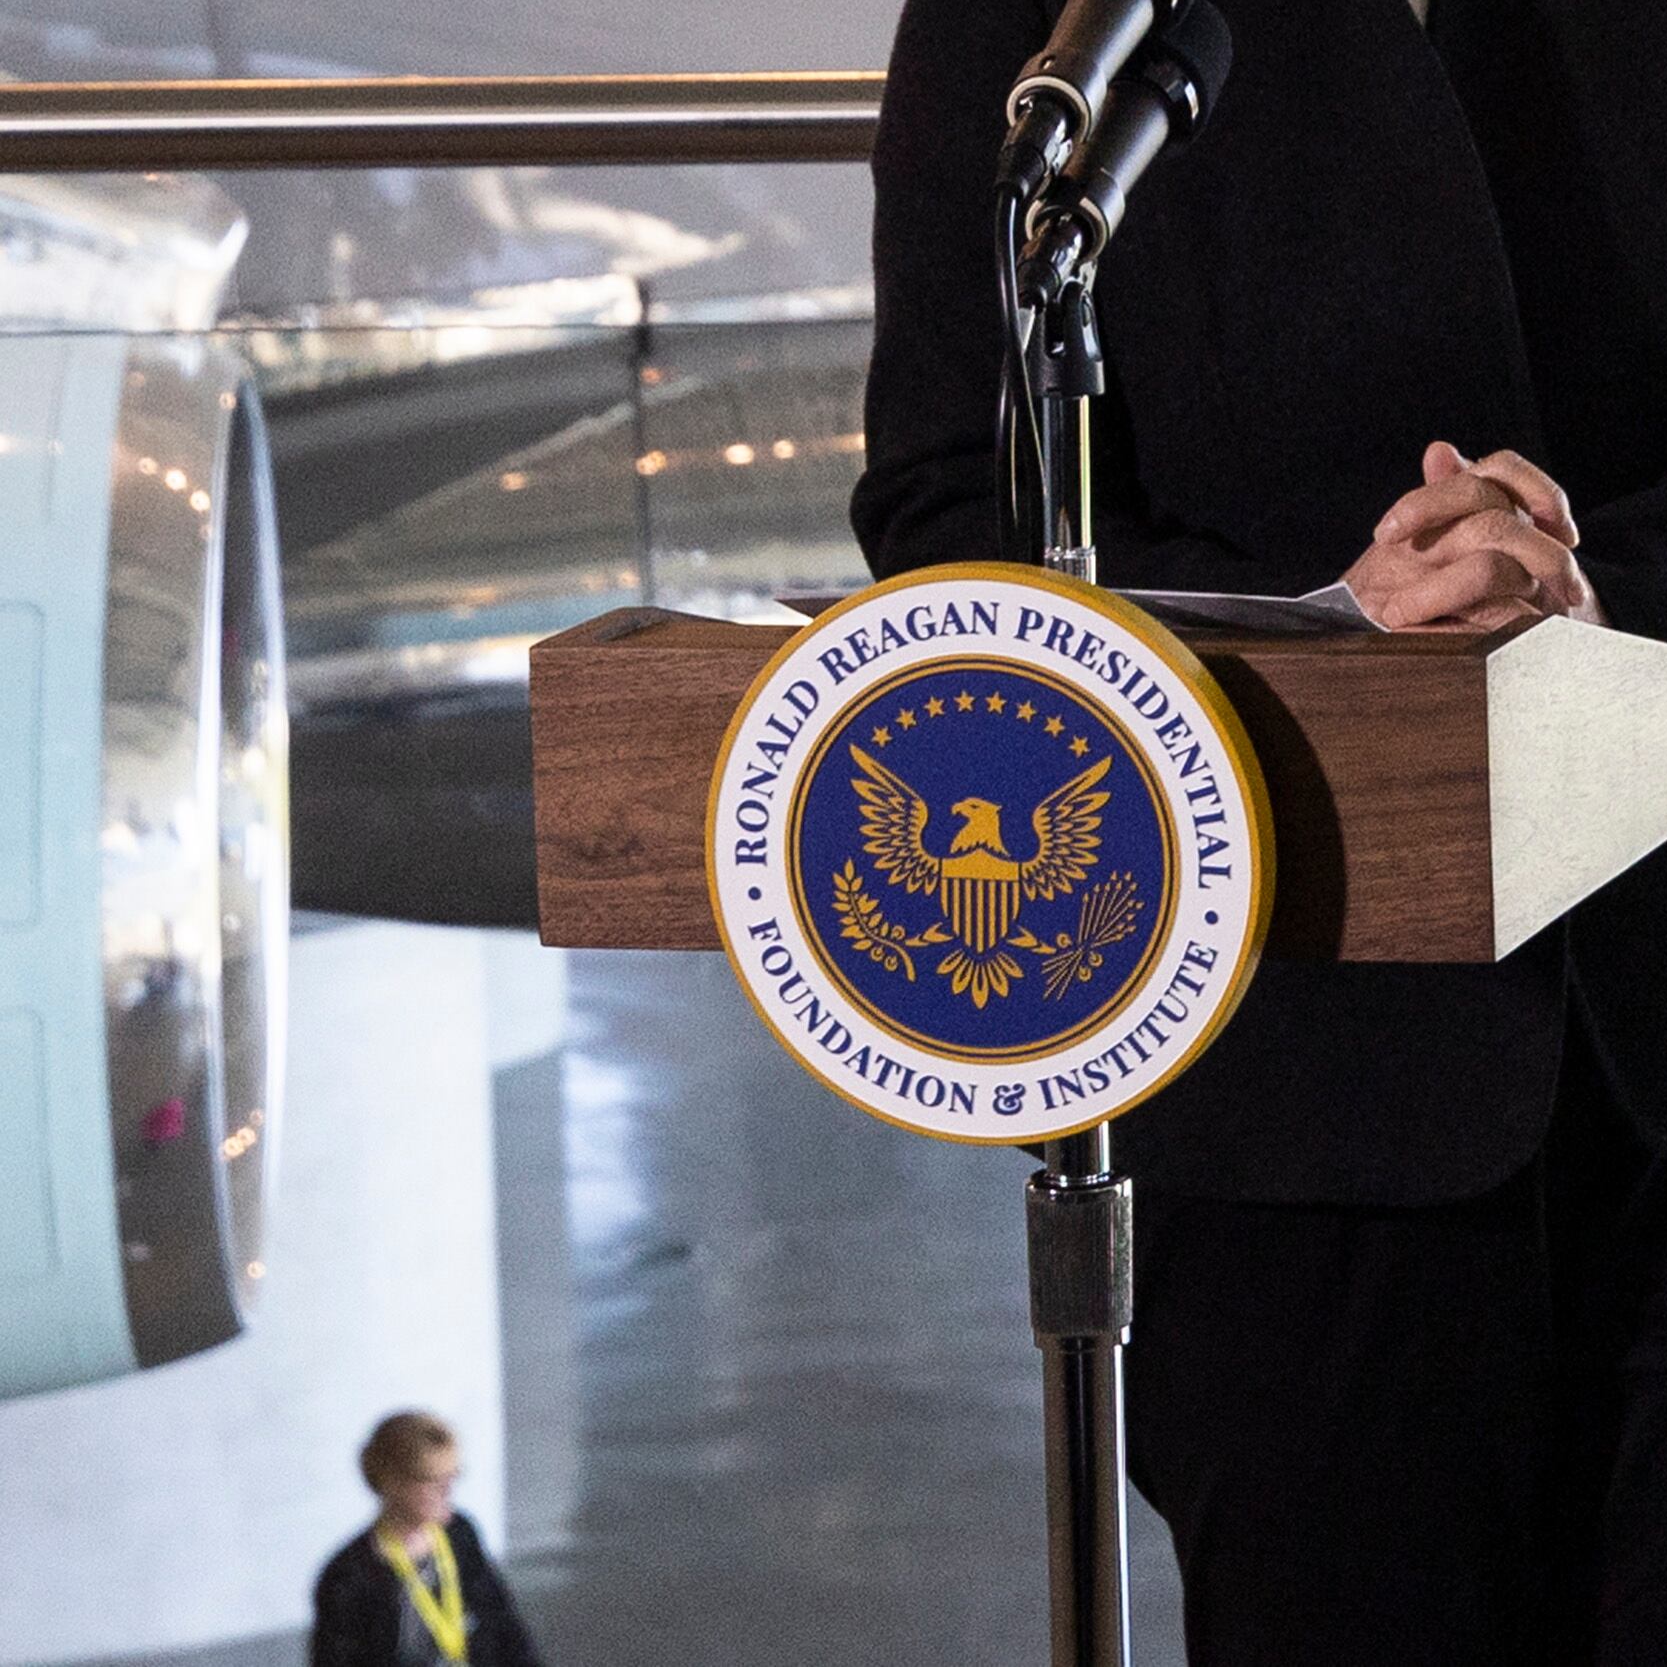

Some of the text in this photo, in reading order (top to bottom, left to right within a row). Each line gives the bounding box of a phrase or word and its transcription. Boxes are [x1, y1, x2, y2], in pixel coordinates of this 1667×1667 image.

[735, 600, 1233, 890] RONALD REAGAN PRESIDENTIAL
[747, 915, 1220, 1116] FOUNDATION & INSTITUTE
